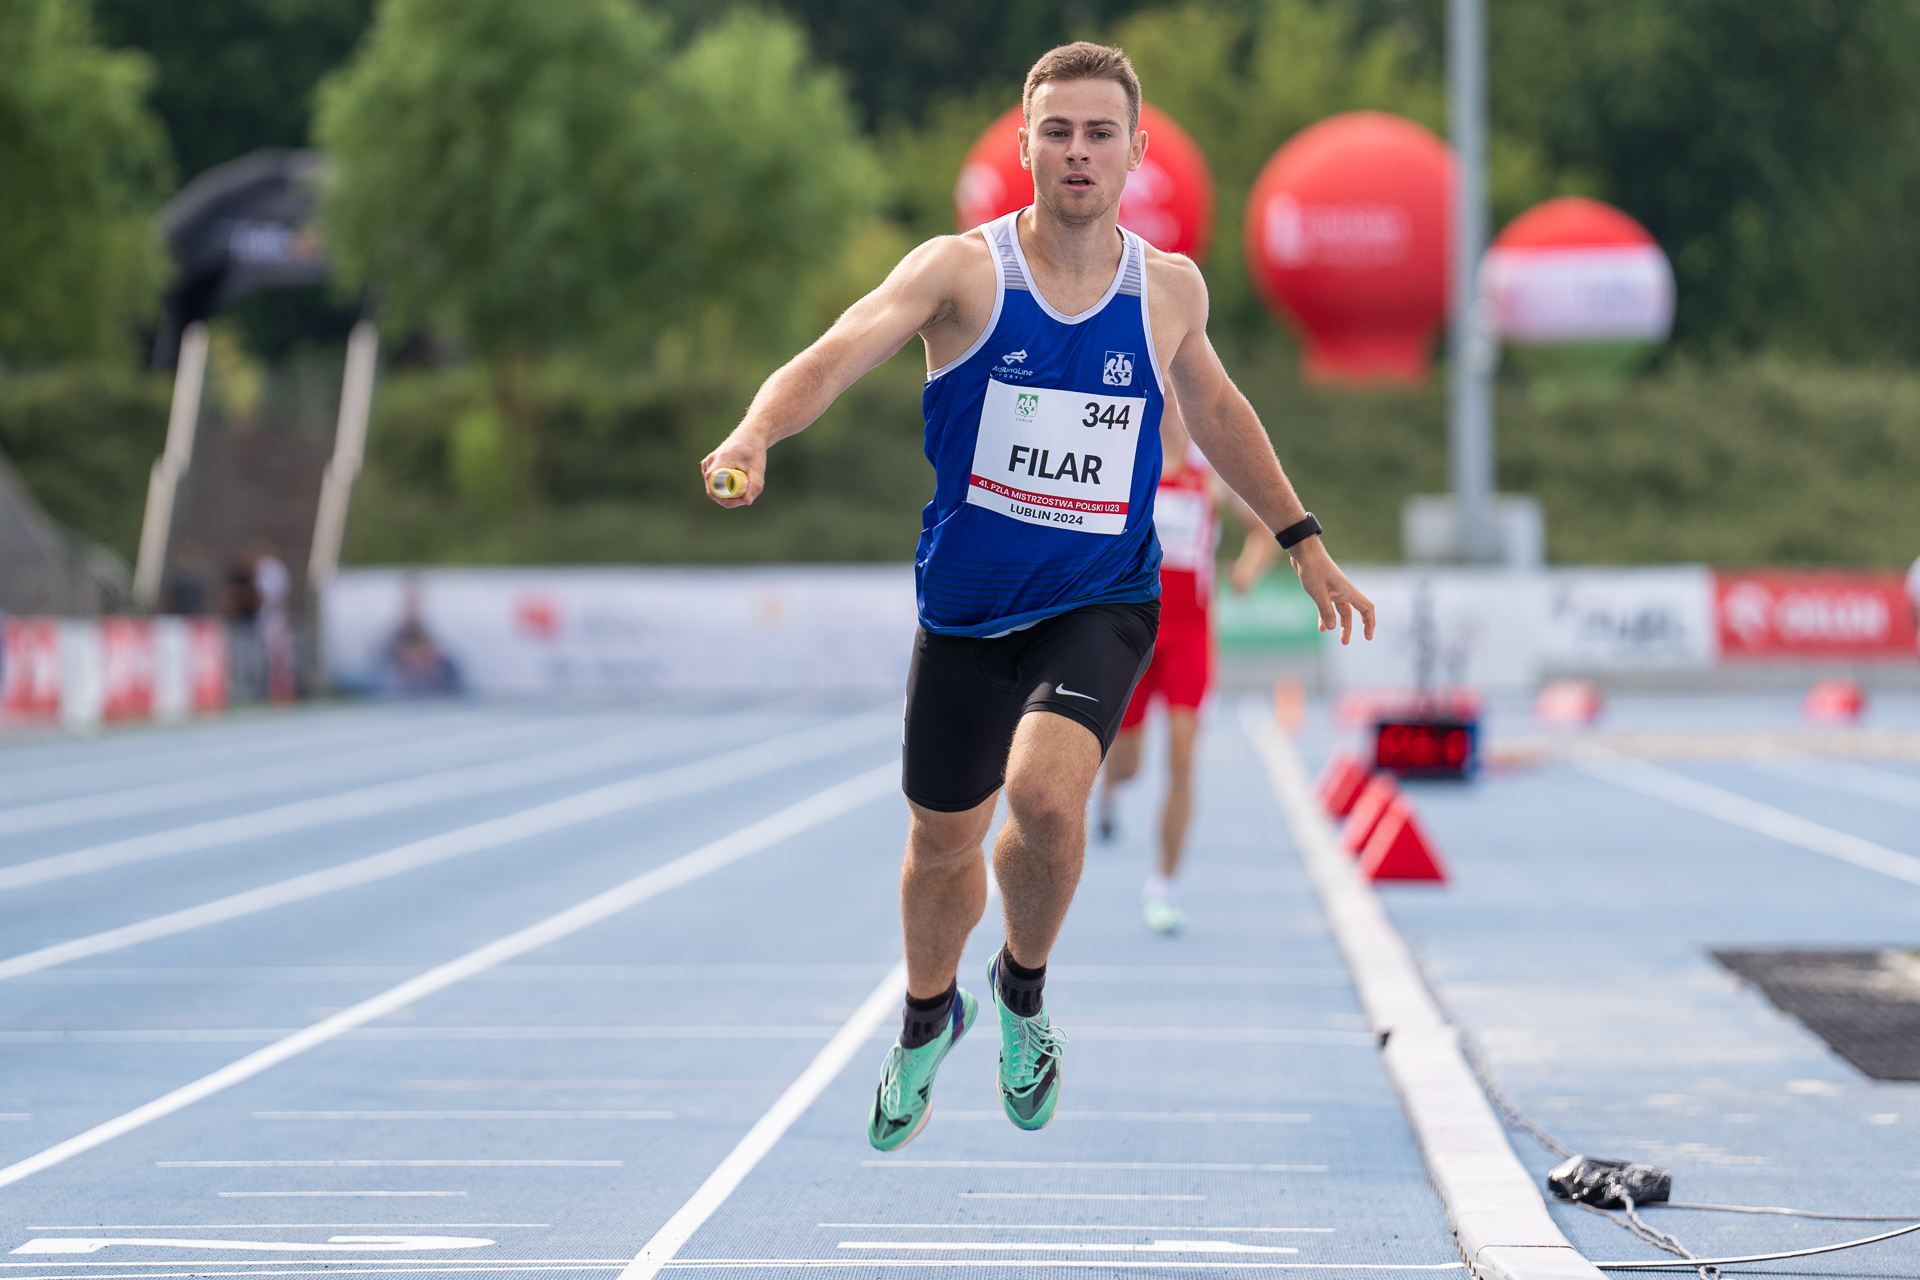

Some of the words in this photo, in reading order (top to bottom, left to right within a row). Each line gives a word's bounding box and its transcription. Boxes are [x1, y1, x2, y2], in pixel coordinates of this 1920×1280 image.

[1082, 401, 1131, 430] 344
[1008, 445, 1102, 485] FILAR
[978, 479, 989, 489] 41.
[990, 483, 1010, 496] PZLA
[1011, 490, 1074, 509] MISTRZOSTWA
[1075, 501, 1104, 512] POLSKI
[1104, 503, 1120, 513] U23
[1009, 503, 1051, 521] LUBLIN
[1053, 512, 1084, 526] 2024
